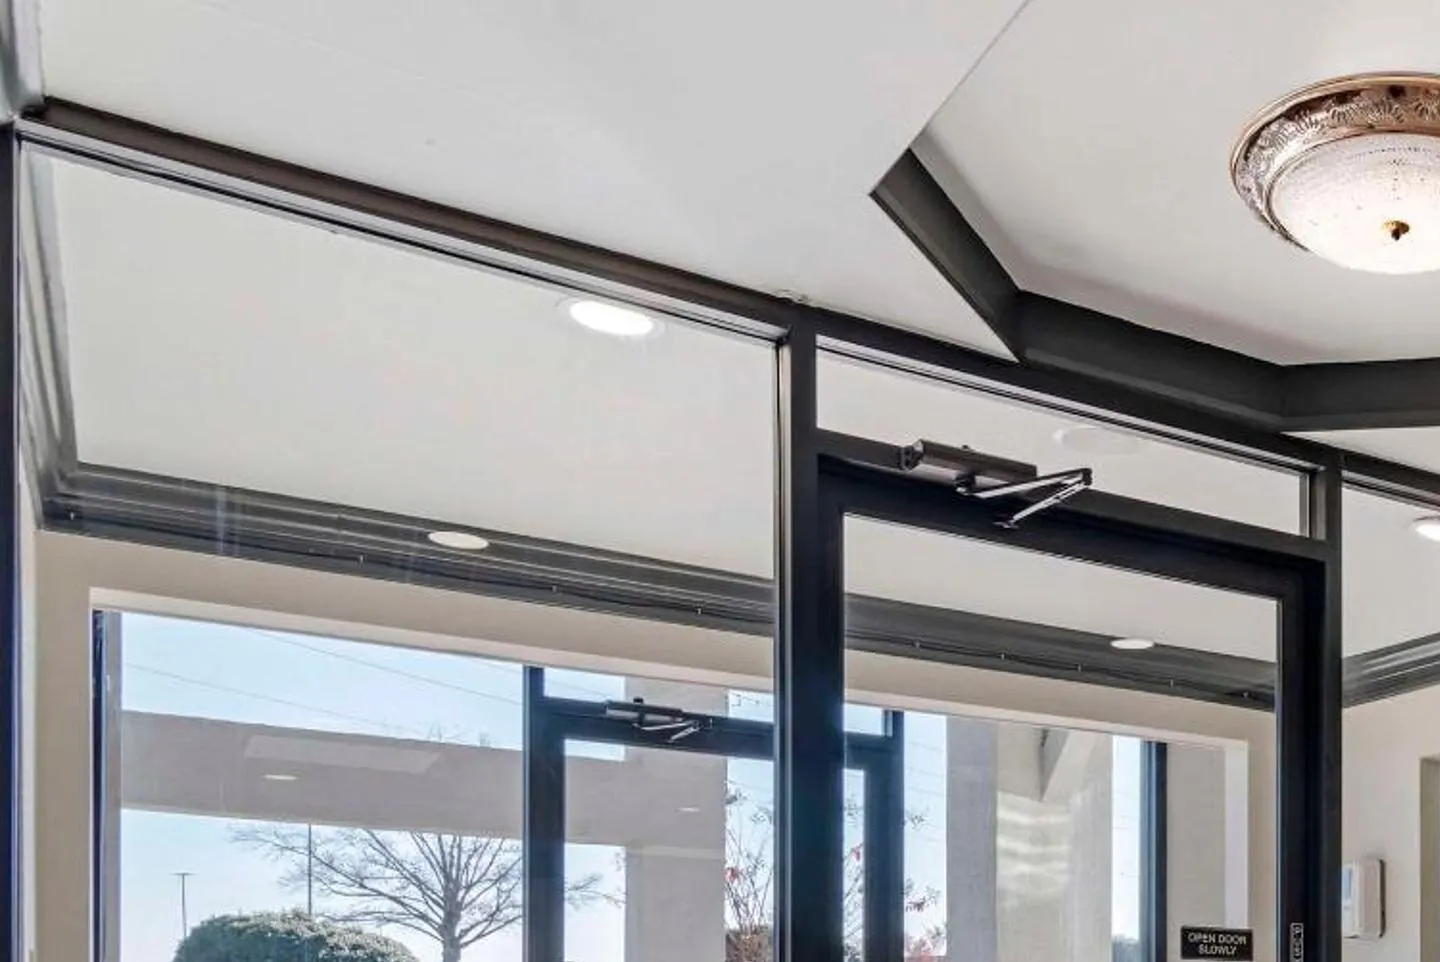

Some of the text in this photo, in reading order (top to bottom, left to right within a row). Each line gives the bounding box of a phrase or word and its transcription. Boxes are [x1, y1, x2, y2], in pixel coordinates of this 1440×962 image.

[1187, 932, 1247, 945] OPEN DOOR
[1199, 943, 1237, 955] SLOWLY
